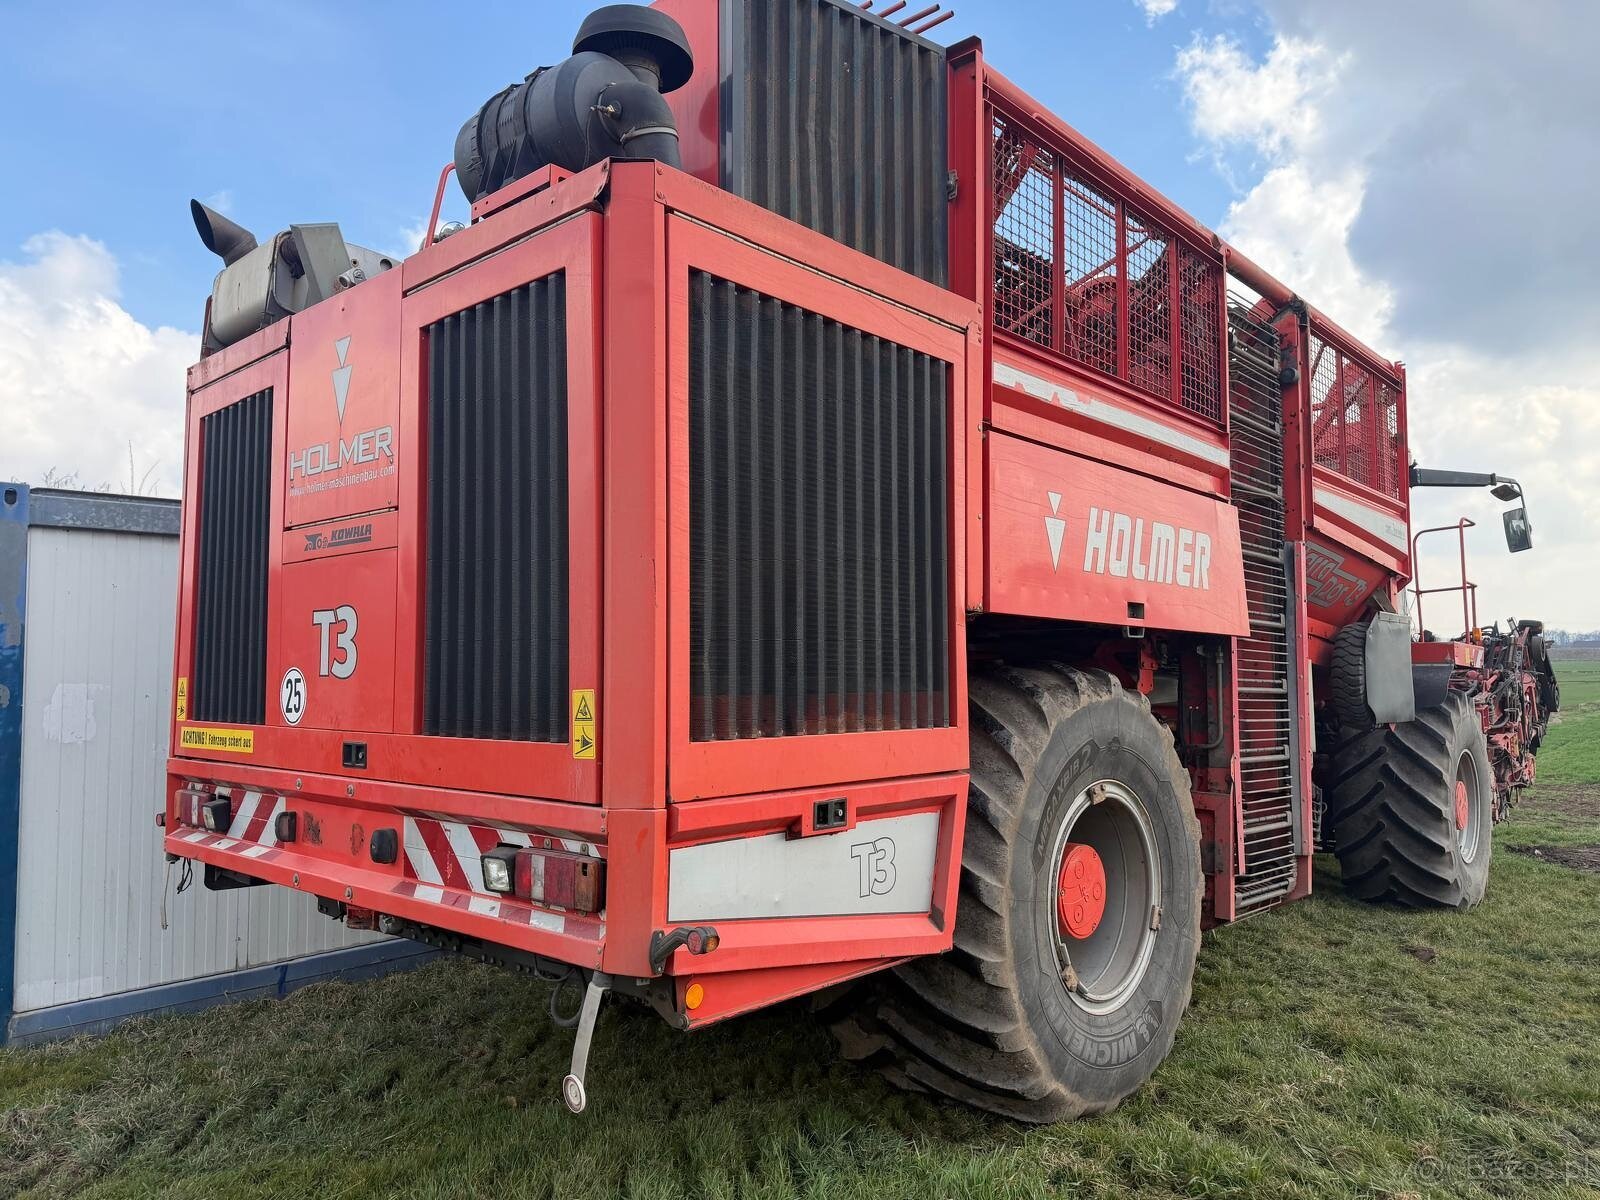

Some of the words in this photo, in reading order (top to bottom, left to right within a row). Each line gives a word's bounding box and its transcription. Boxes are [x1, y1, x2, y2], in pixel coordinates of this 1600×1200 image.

[289, 425, 394, 482] HOLMER
[1083, 506, 1212, 590] HOLMER
[312, 604, 359, 680] T3
[285, 678, 302, 714] 25
[850, 836, 897, 898] T3
